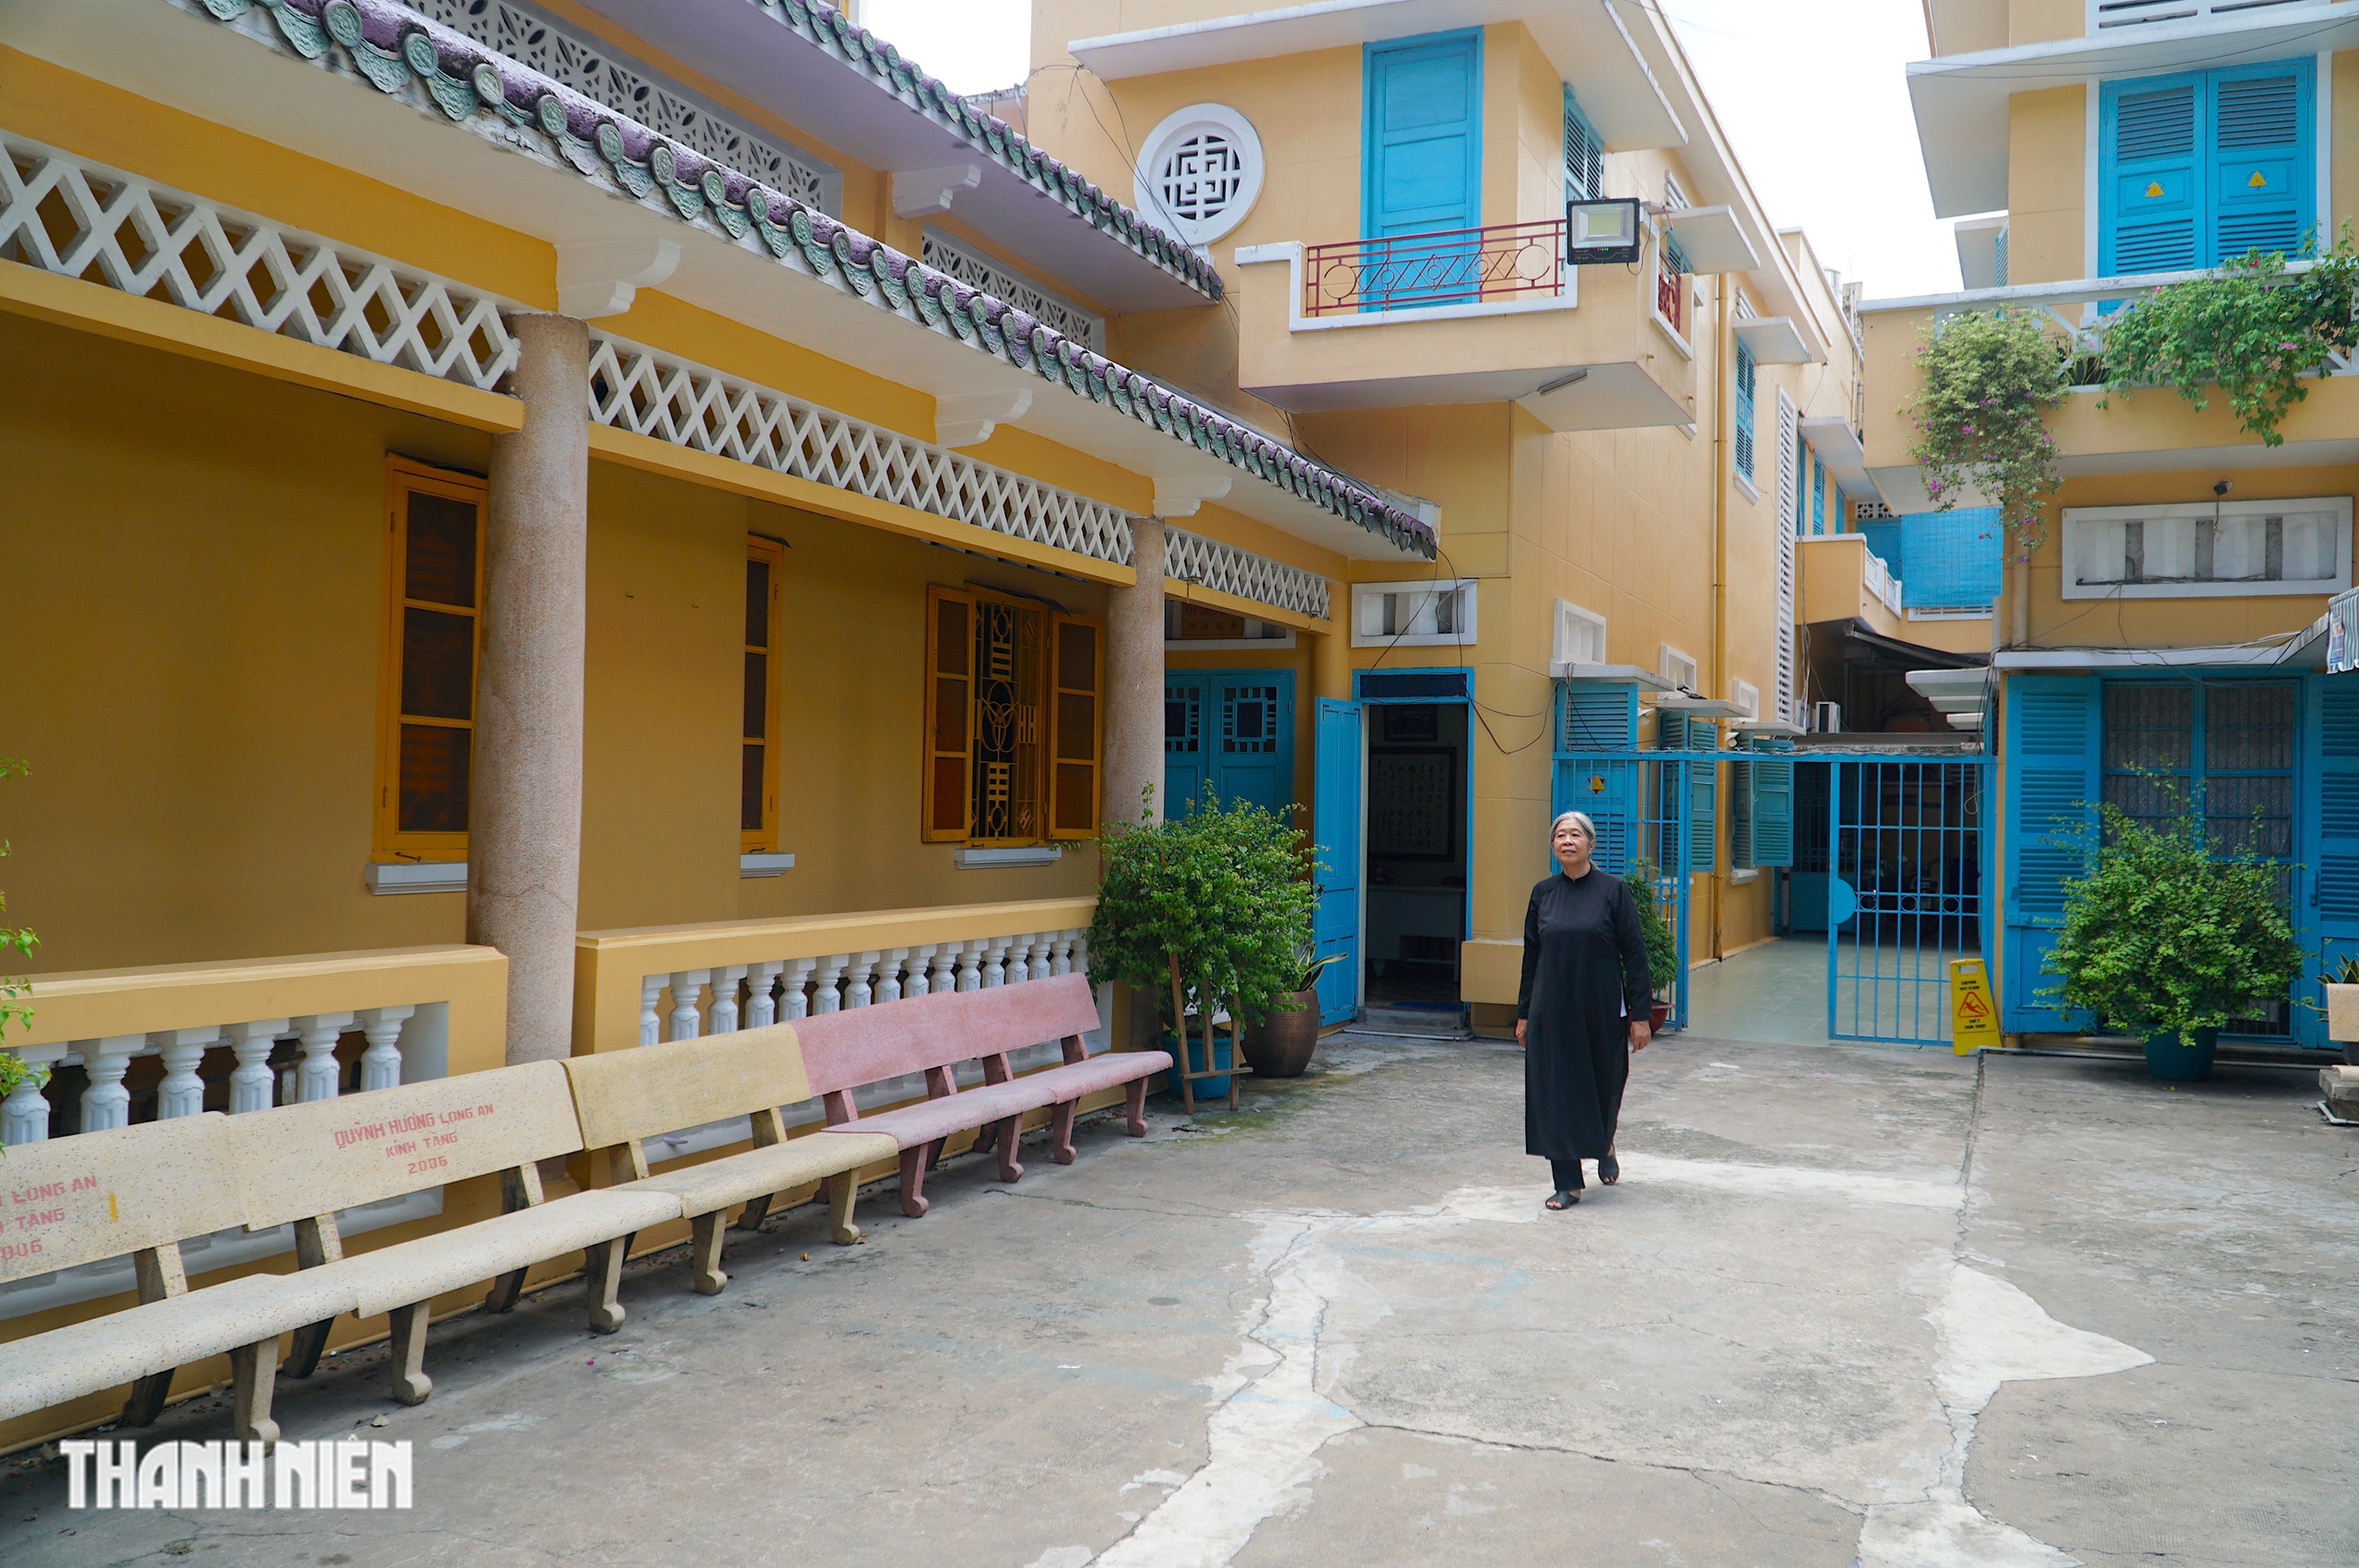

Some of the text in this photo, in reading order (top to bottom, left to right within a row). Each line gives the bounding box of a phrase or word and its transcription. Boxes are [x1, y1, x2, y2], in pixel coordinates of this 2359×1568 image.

[439, 1107, 474, 1125] LONG
[477, 1104, 494, 1117] AN
[385, 1139, 417, 1158] KÍNH
[408, 1155, 448, 1175] 2006
[11, 1182, 65, 1204] LONG
[71, 1175, 97, 1193] AN
[0, 1238, 43, 1260] 006
